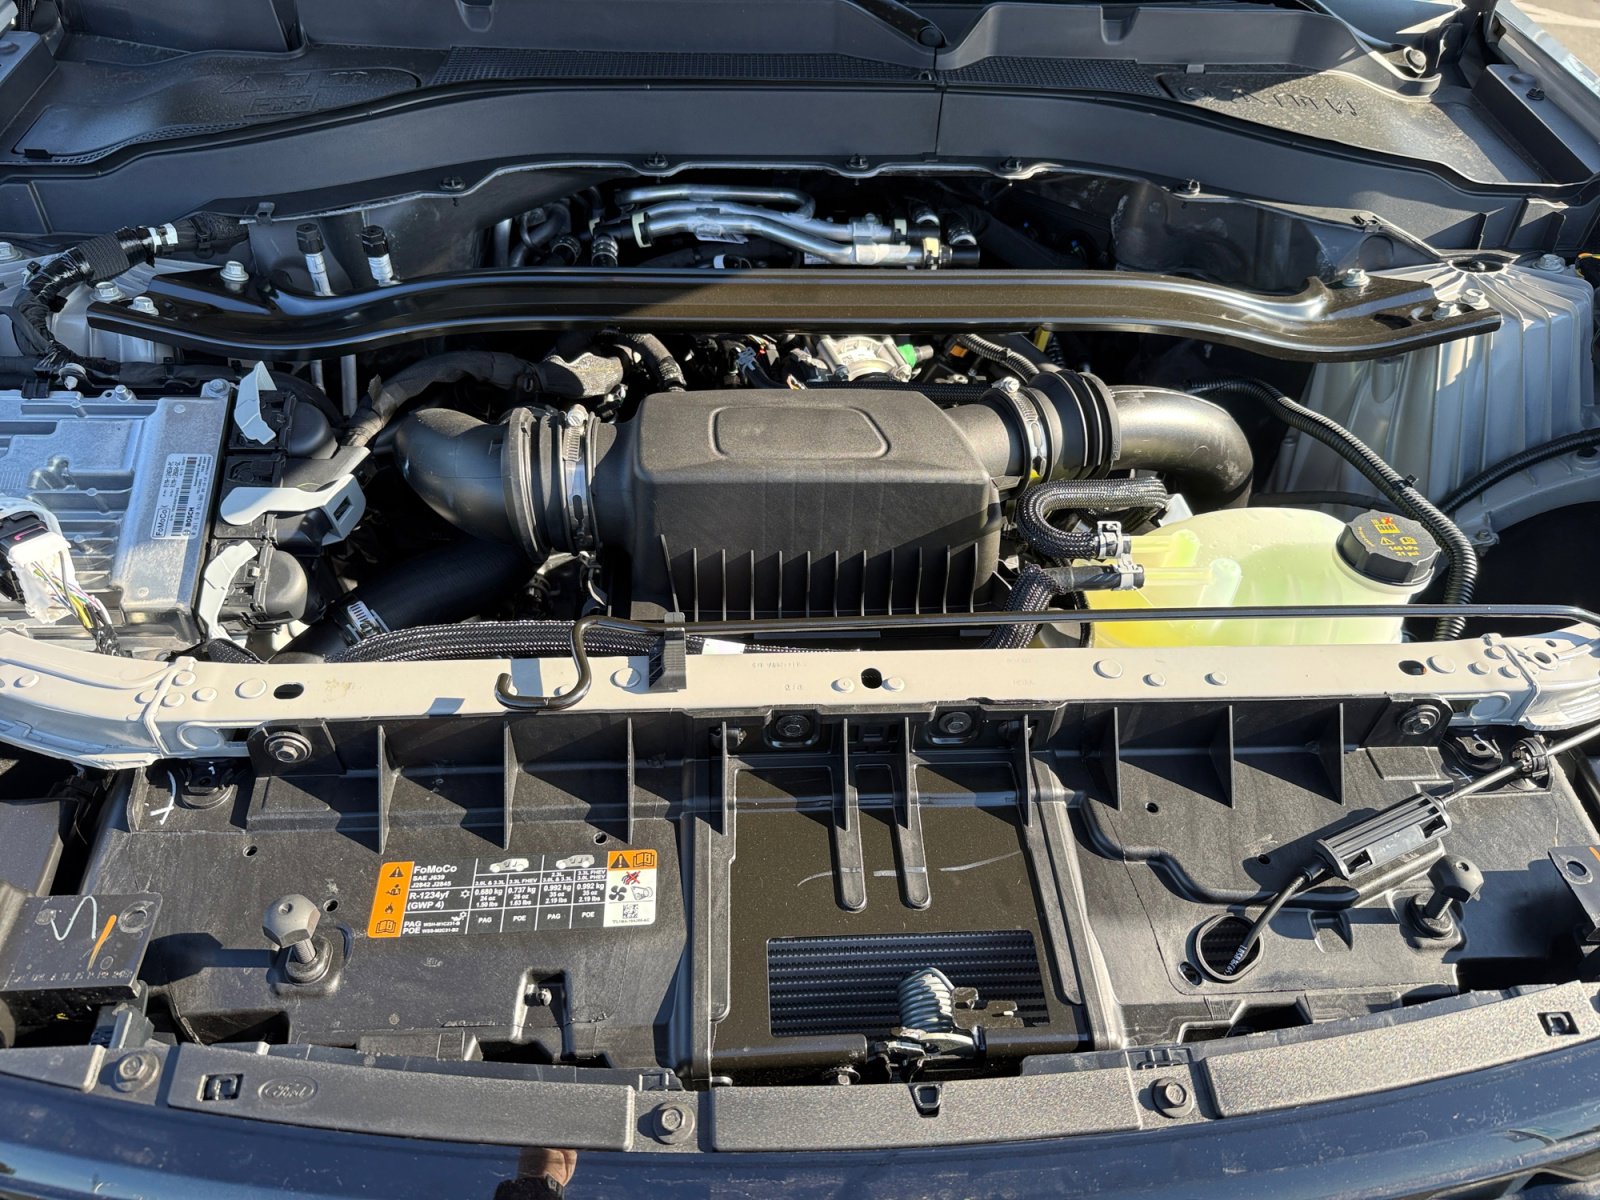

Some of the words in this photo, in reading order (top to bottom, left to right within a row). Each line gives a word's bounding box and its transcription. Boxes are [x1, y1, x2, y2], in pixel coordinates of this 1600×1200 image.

[185, 506, 195, 527] BOSCH
[156, 509, 168, 536] FoMoCo
[414, 864, 457, 874] FoMoCo
[527, 886, 537, 894] kg
[543, 884, 562, 892] 0.992
[562, 884, 572, 892] kg
[596, 882, 605, 891] kg
[409, 890, 450, 900] R-1234yf
[474, 888, 493, 896] 0.680
[494, 888, 503, 897] kg
[407, 901, 434, 910] (GWP
[435, 901, 445, 909] 4)
